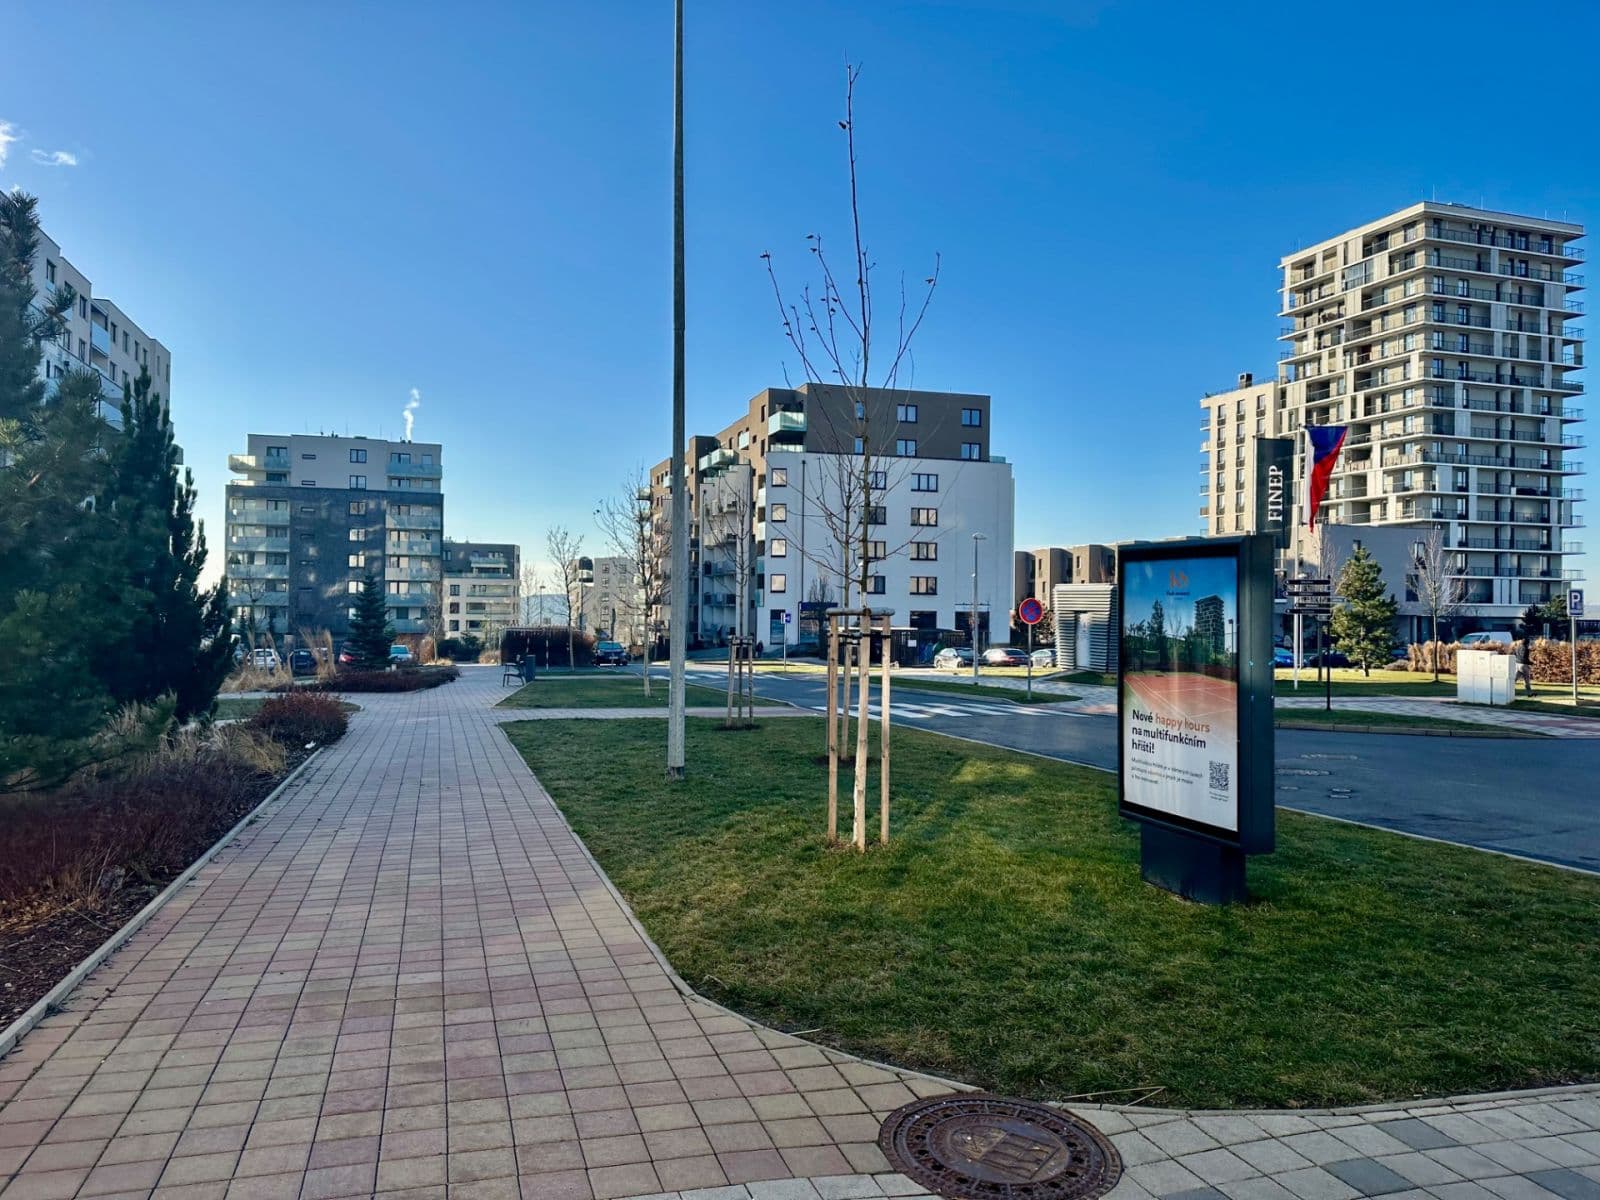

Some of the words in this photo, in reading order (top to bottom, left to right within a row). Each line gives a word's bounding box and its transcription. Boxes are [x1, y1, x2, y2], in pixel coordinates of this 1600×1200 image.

[1268, 465, 1283, 521] FINEP
[1571, 591, 1580, 609] P
[1132, 709, 1153, 723] Nové
[1155, 713, 1182, 731] happy
[1184, 717, 1210, 732] hours
[1132, 727, 1142, 735] na
[1143, 728, 1206, 749] multifunkčním
